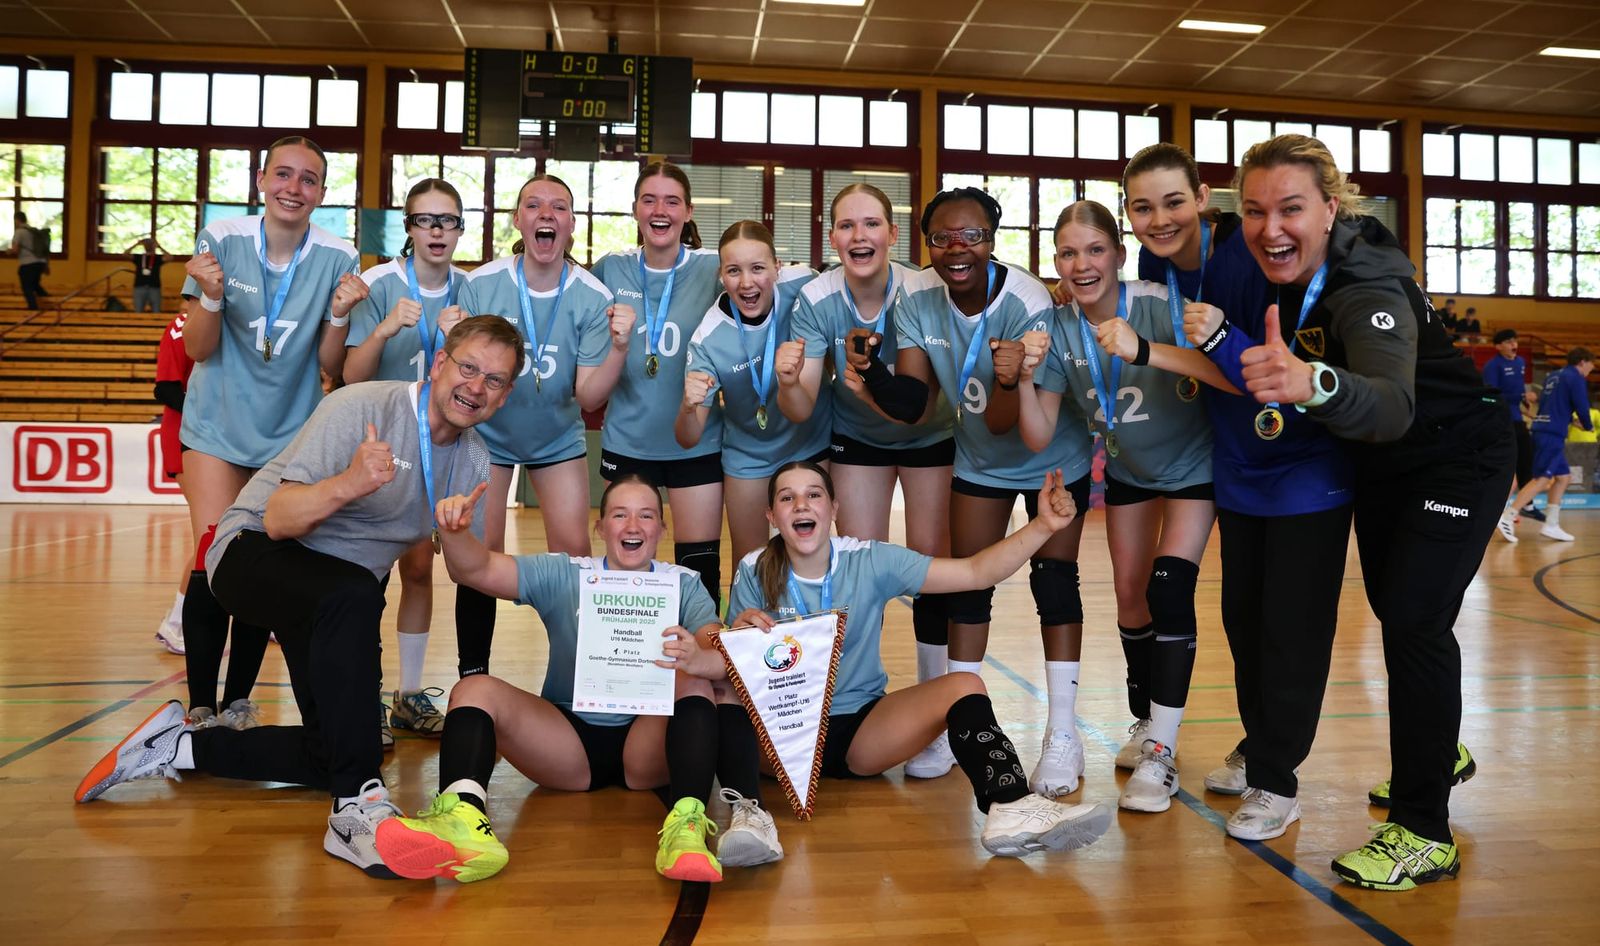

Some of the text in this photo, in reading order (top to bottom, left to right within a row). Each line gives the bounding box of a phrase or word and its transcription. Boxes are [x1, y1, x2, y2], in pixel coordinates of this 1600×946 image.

[525, 54, 536, 70] H
[623, 58, 634, 74] G
[228, 278, 257, 293] Kempa
[617, 288, 642, 299] Kempa
[249, 316, 298, 355] 17
[637, 322, 680, 357] 10
[1204, 329, 1227, 352] Kempa
[410, 350, 430, 381] 1
[963, 377, 987, 414] 9
[27, 437, 101, 481] DB
[1424, 500, 1468, 517] Kempa
[593, 594, 666, 608] URKUNDE
[598, 608, 659, 617] BUNDESFINALE
[602, 616, 638, 624] FRÜHJAHR
[768, 672, 805, 684] Jugend trainiert
[778, 709, 802, 717] Mädchen
[779, 721, 803, 731] Handball
